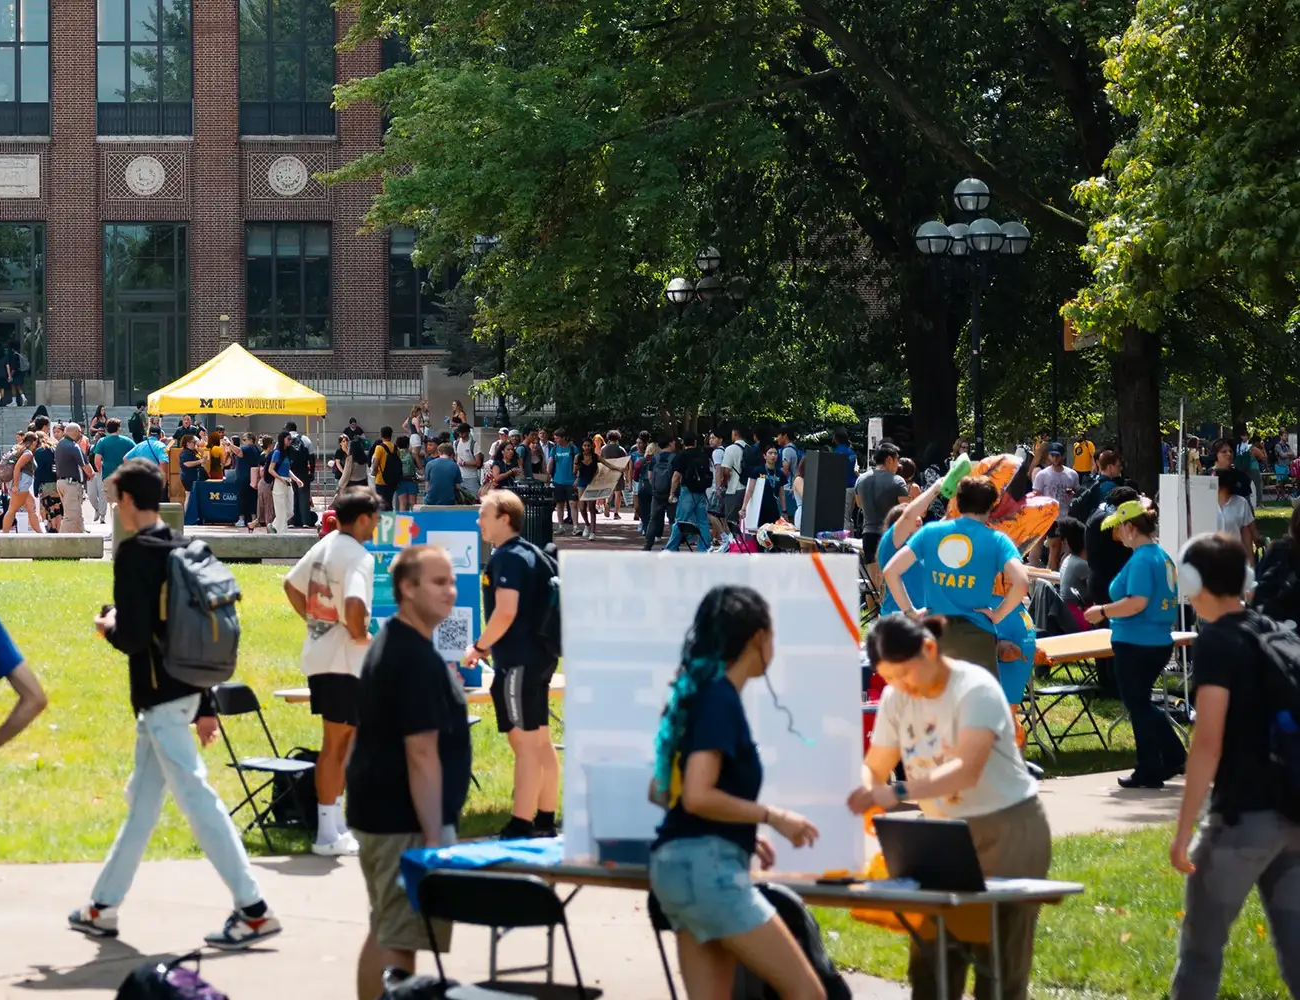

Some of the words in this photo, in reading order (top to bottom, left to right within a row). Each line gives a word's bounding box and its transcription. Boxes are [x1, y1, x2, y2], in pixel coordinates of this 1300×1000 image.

[200, 398, 213, 408] M
[218, 398, 243, 409] CAMPUS
[245, 398, 286, 410] INVOLVEMENT
[209, 491, 220, 500] M
